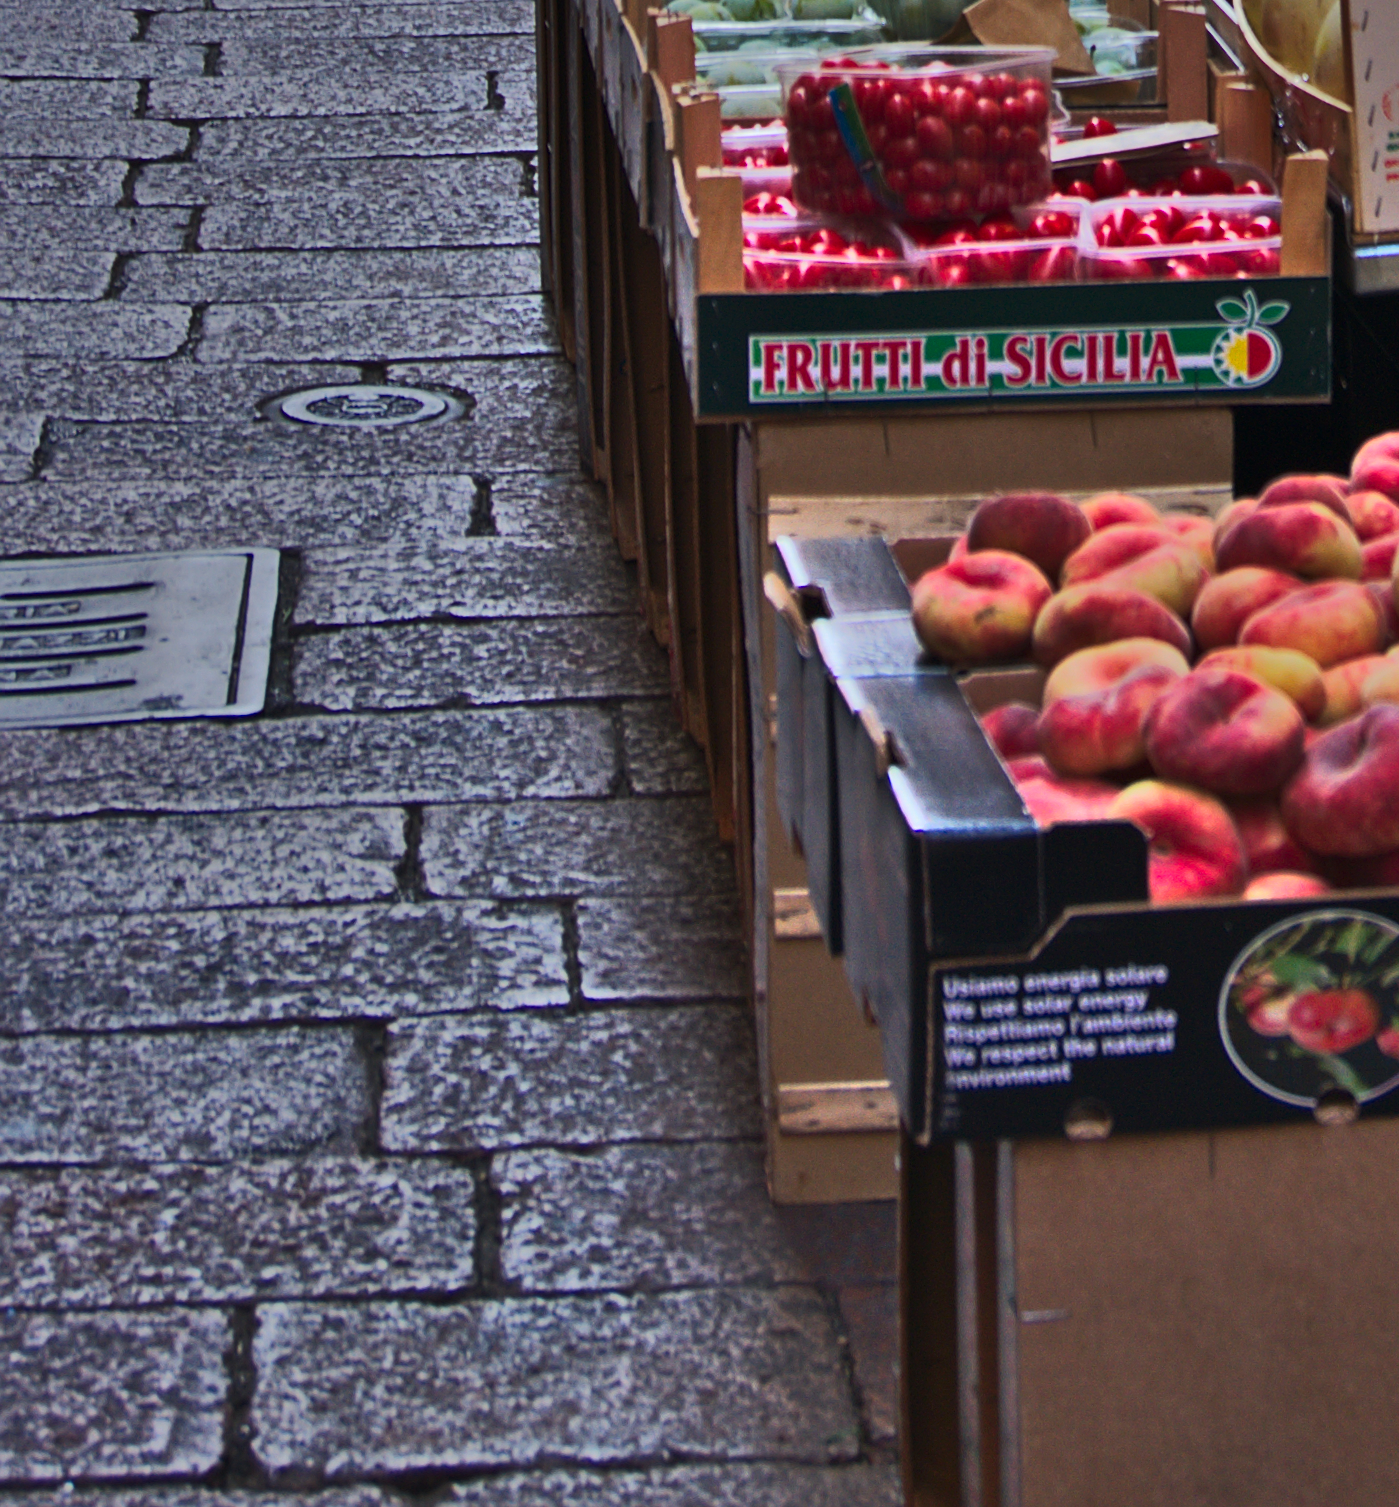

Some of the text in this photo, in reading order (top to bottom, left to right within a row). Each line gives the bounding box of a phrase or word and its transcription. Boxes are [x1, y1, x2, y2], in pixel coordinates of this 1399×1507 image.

[760, 331, 1184, 394] FRUTTI di SICILIA
[942, 962, 1169, 999] Usiamo energia solare
[943, 989, 1150, 1022] We use solar energy
[944, 1007, 1178, 1045] Rispettiamo l'ambiente
[944, 1031, 1176, 1068] We respect the natural
